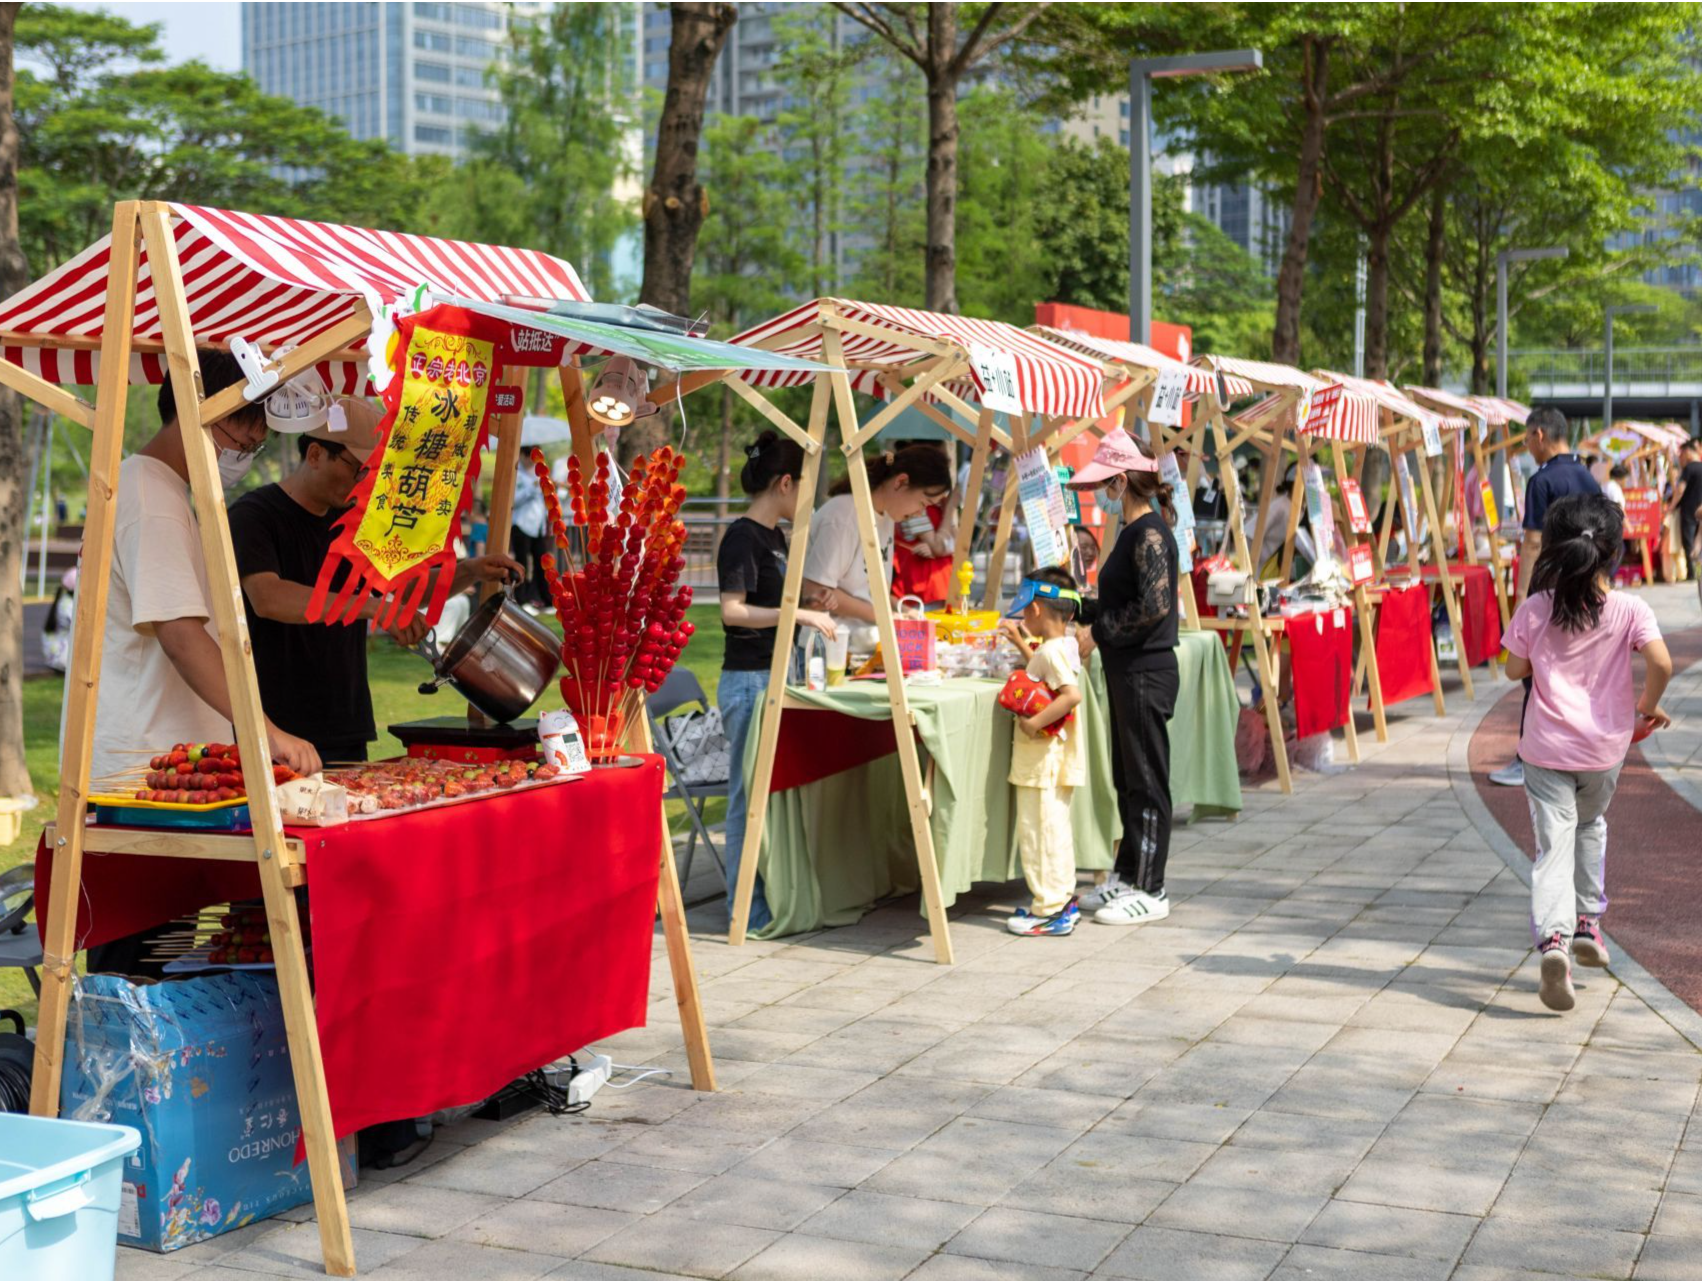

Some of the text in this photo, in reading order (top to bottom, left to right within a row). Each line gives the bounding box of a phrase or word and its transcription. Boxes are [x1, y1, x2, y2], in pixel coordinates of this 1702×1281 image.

[411, 353, 488, 387] 正宗老北京
[384, 388, 460, 537] 冰糖葫芦
[435, 413, 479, 516] 现做现卖
[896, 628, 927, 640] OOD
